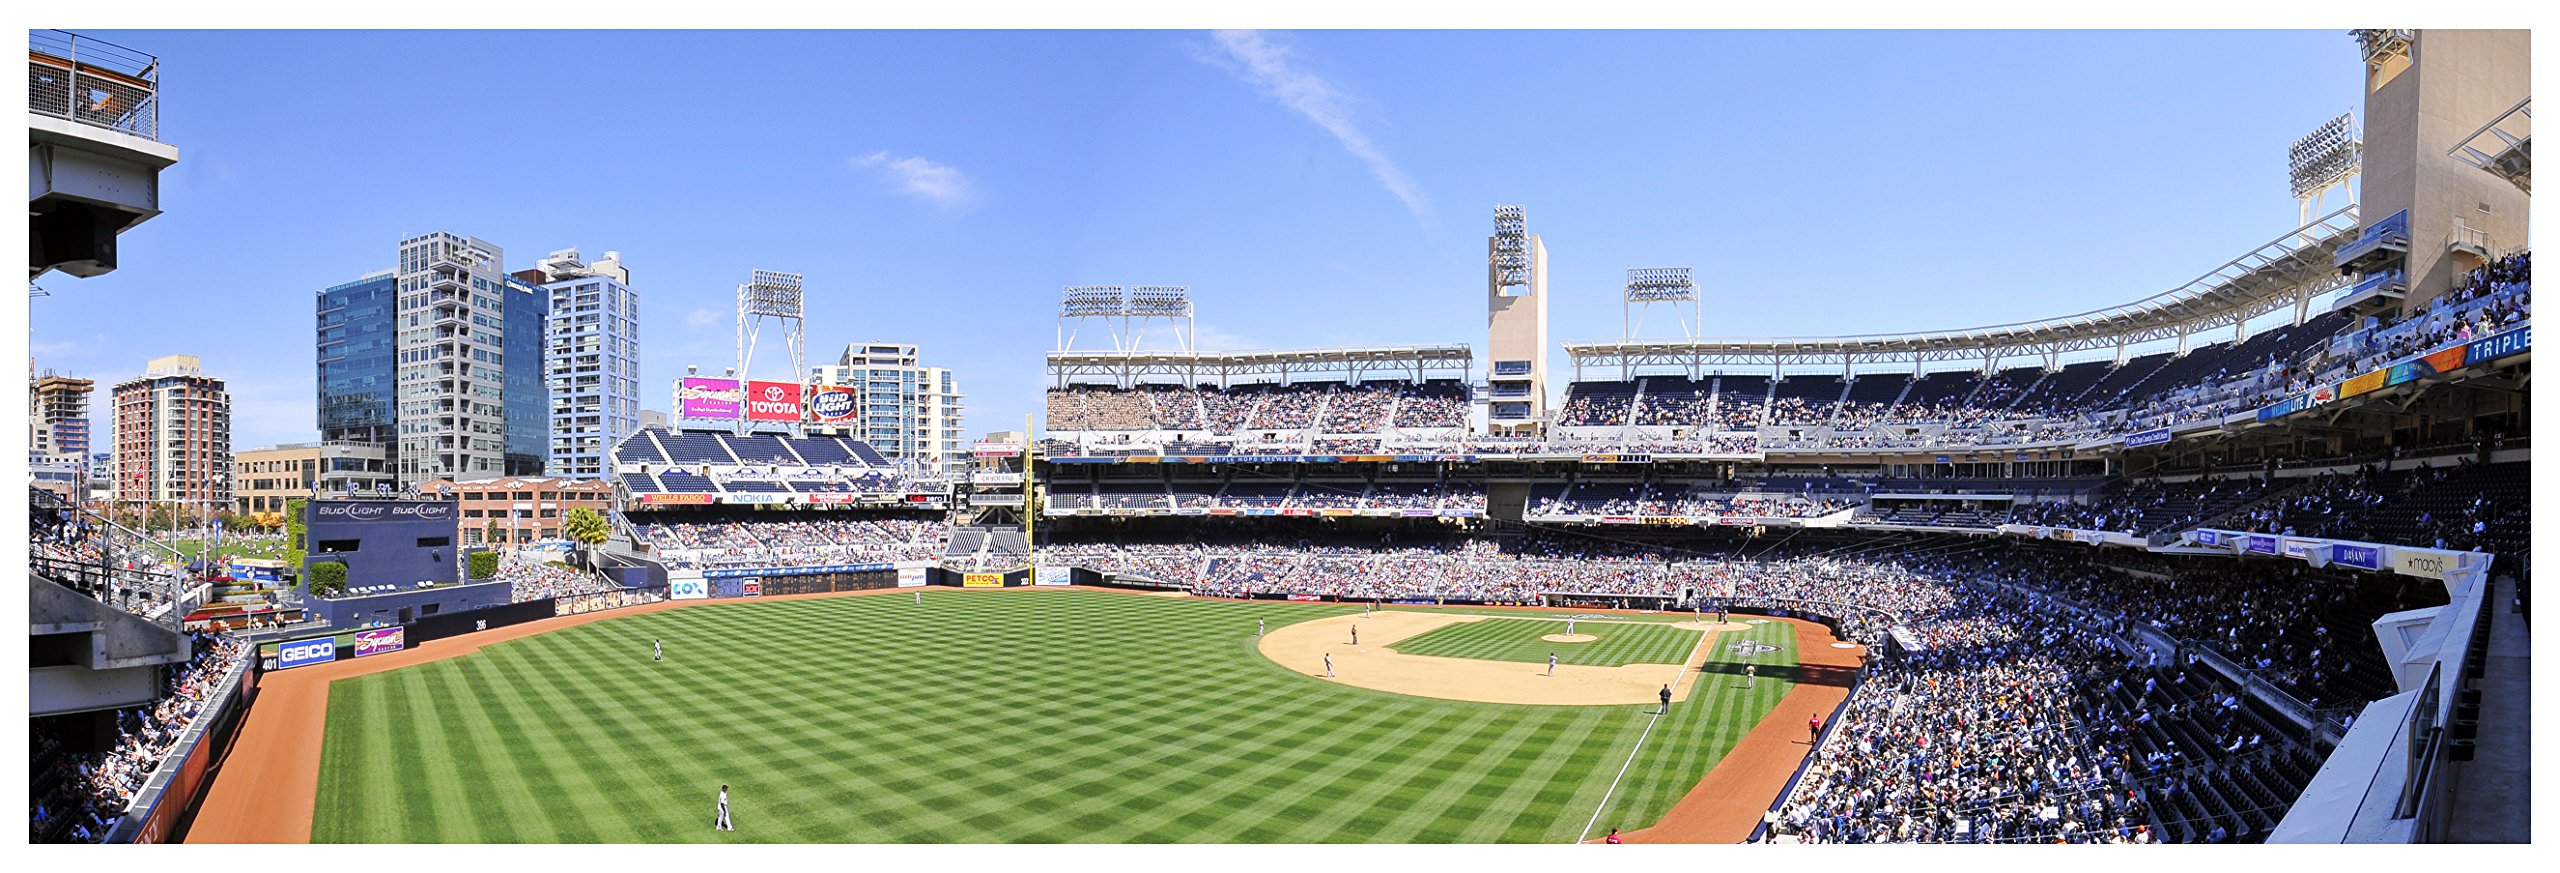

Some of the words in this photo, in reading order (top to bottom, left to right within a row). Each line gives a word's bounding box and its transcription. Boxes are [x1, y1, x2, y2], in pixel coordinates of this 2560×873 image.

[2473, 330, 2531, 360] TRIPLE
[819, 393, 849, 403] BUD
[750, 401, 798, 415] TOYOTA
[816, 400, 852, 411] LIGHT
[651, 494, 678, 502] WELLS
[680, 494, 705, 502] FARGO
[733, 494, 774, 502] NOKIA
[319, 506, 346, 515] BUD
[351, 506, 384, 515] LIGHT
[392, 506, 415, 515] BUD
[420, 506, 448, 515] LIGHT
[476, 619, 487, 631] 396
[281, 642, 333, 663] GEICO
[262, 658, 277, 671] 401
